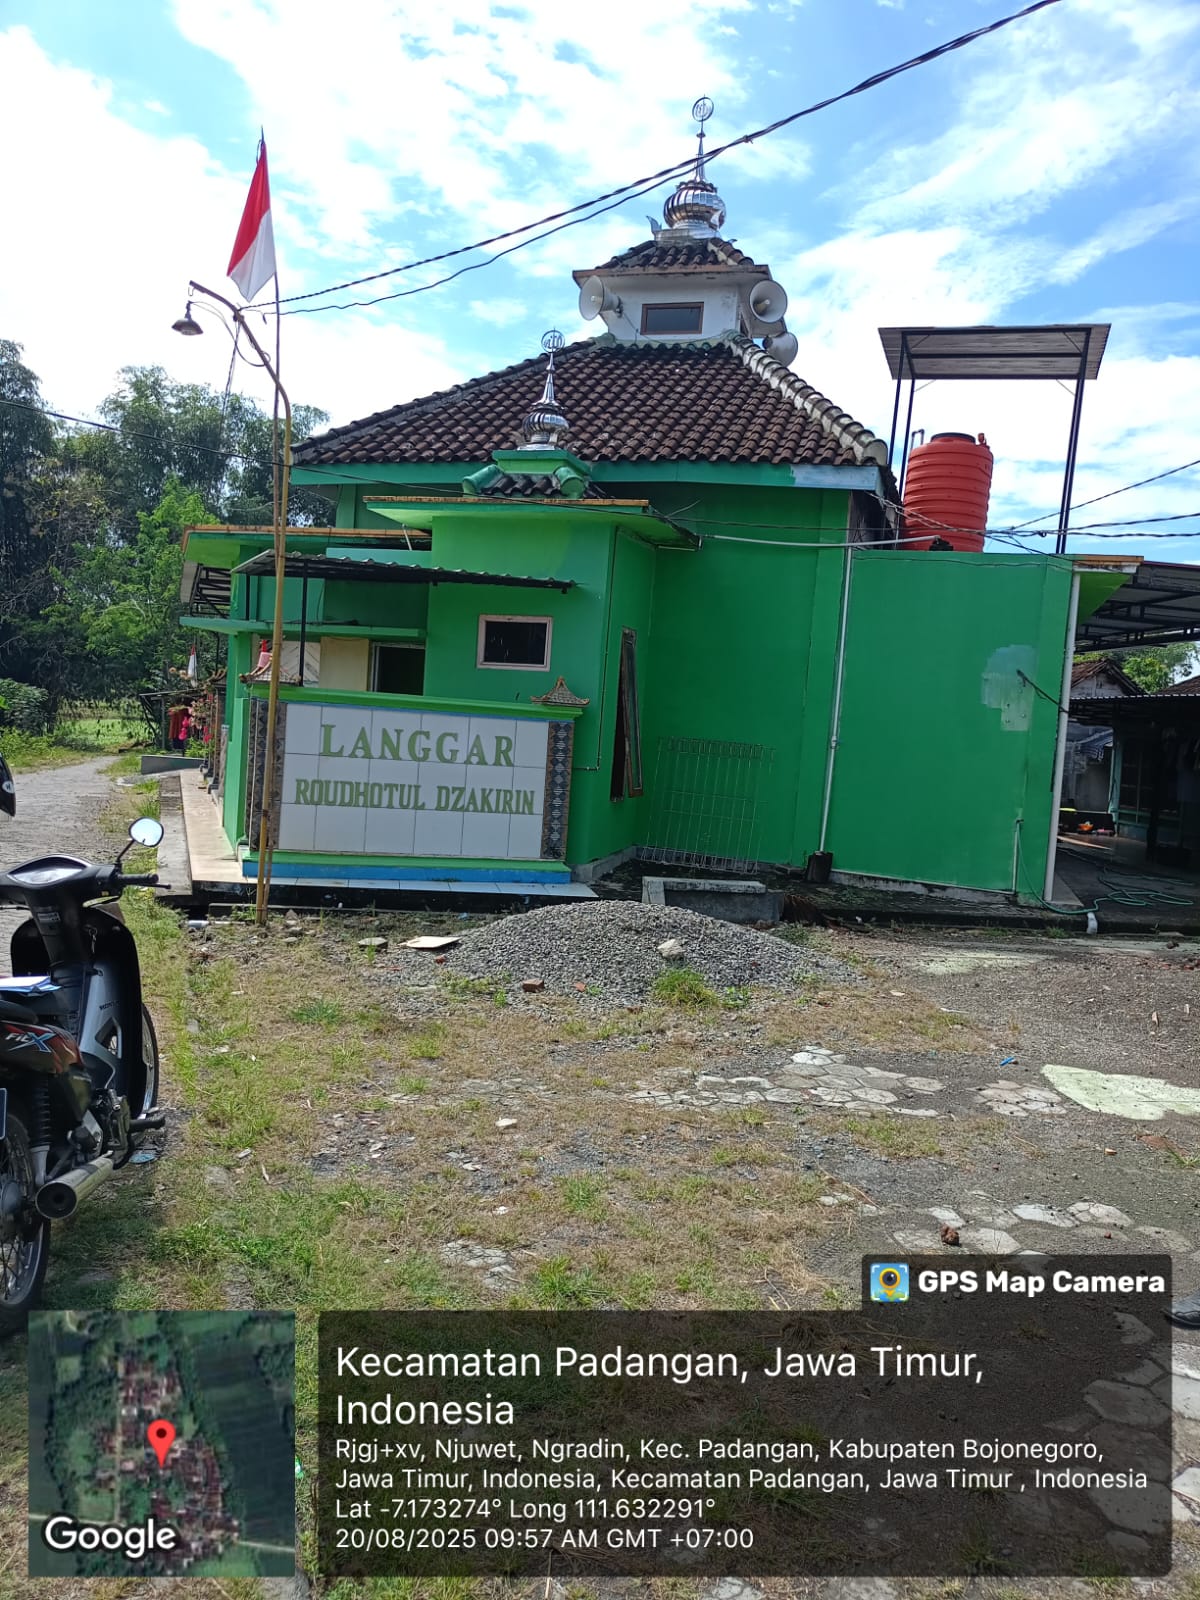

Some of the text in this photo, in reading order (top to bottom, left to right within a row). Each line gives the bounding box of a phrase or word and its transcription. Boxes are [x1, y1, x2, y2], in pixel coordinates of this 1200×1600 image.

[320, 724, 514, 767] LANGGAR
[295, 778, 536, 815] ROUDHOTUL DZAKIRIN
